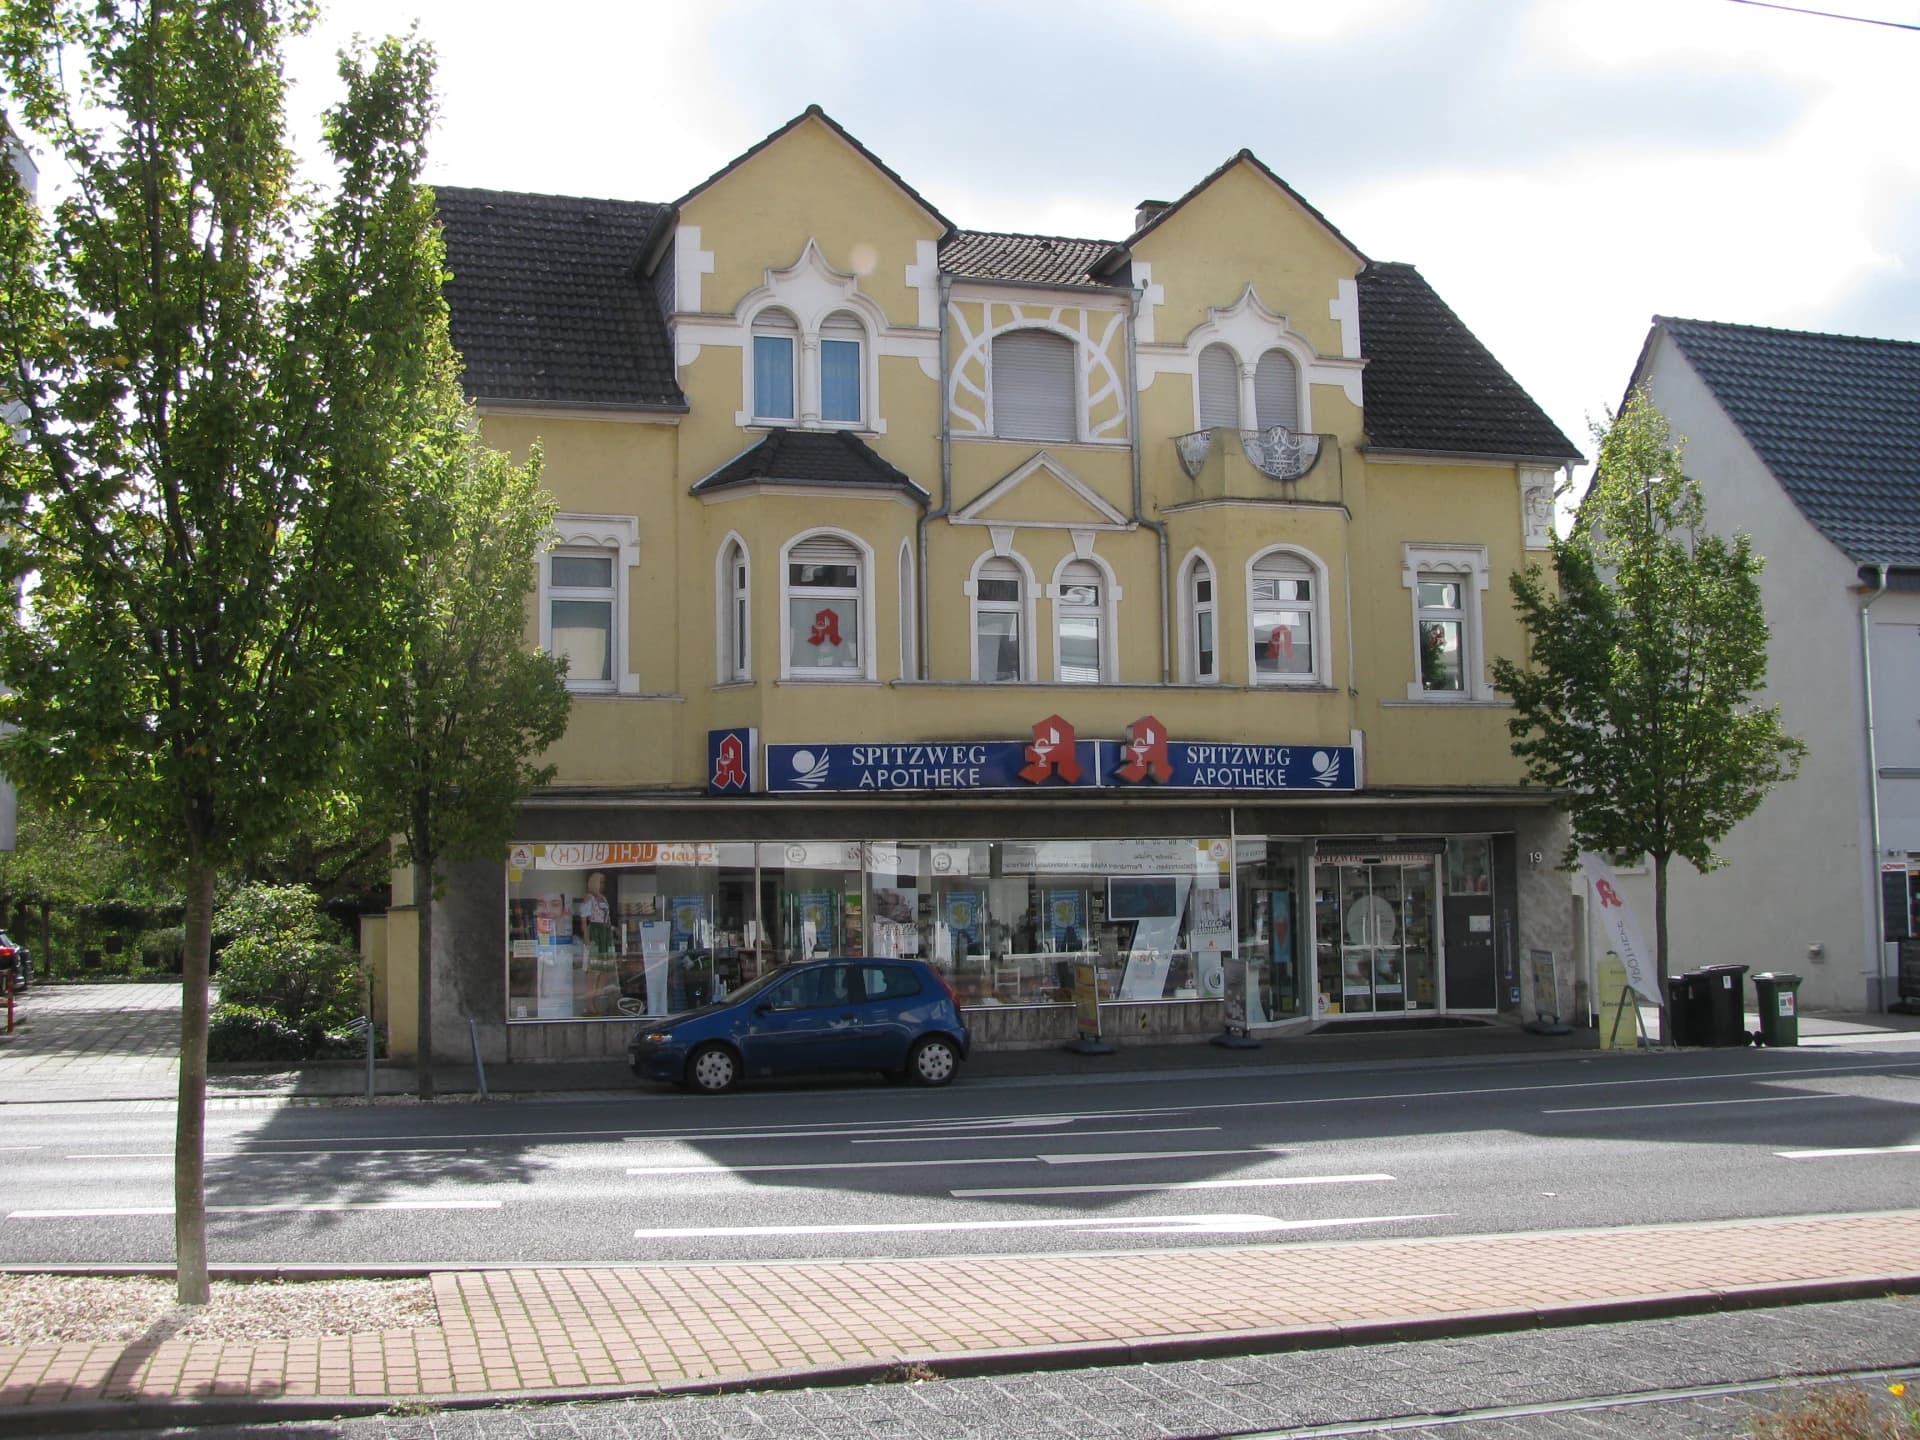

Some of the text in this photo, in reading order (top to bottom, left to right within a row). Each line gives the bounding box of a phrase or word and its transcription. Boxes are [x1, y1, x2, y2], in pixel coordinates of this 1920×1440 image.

[851, 746, 987, 766] SPITZWEG
[1186, 746, 1291, 766] SPITZWEG
[859, 768, 981, 788] APOTHEKE
[1192, 768, 1287, 787] APOTHEKE
[1529, 851, 1542, 863] 19
